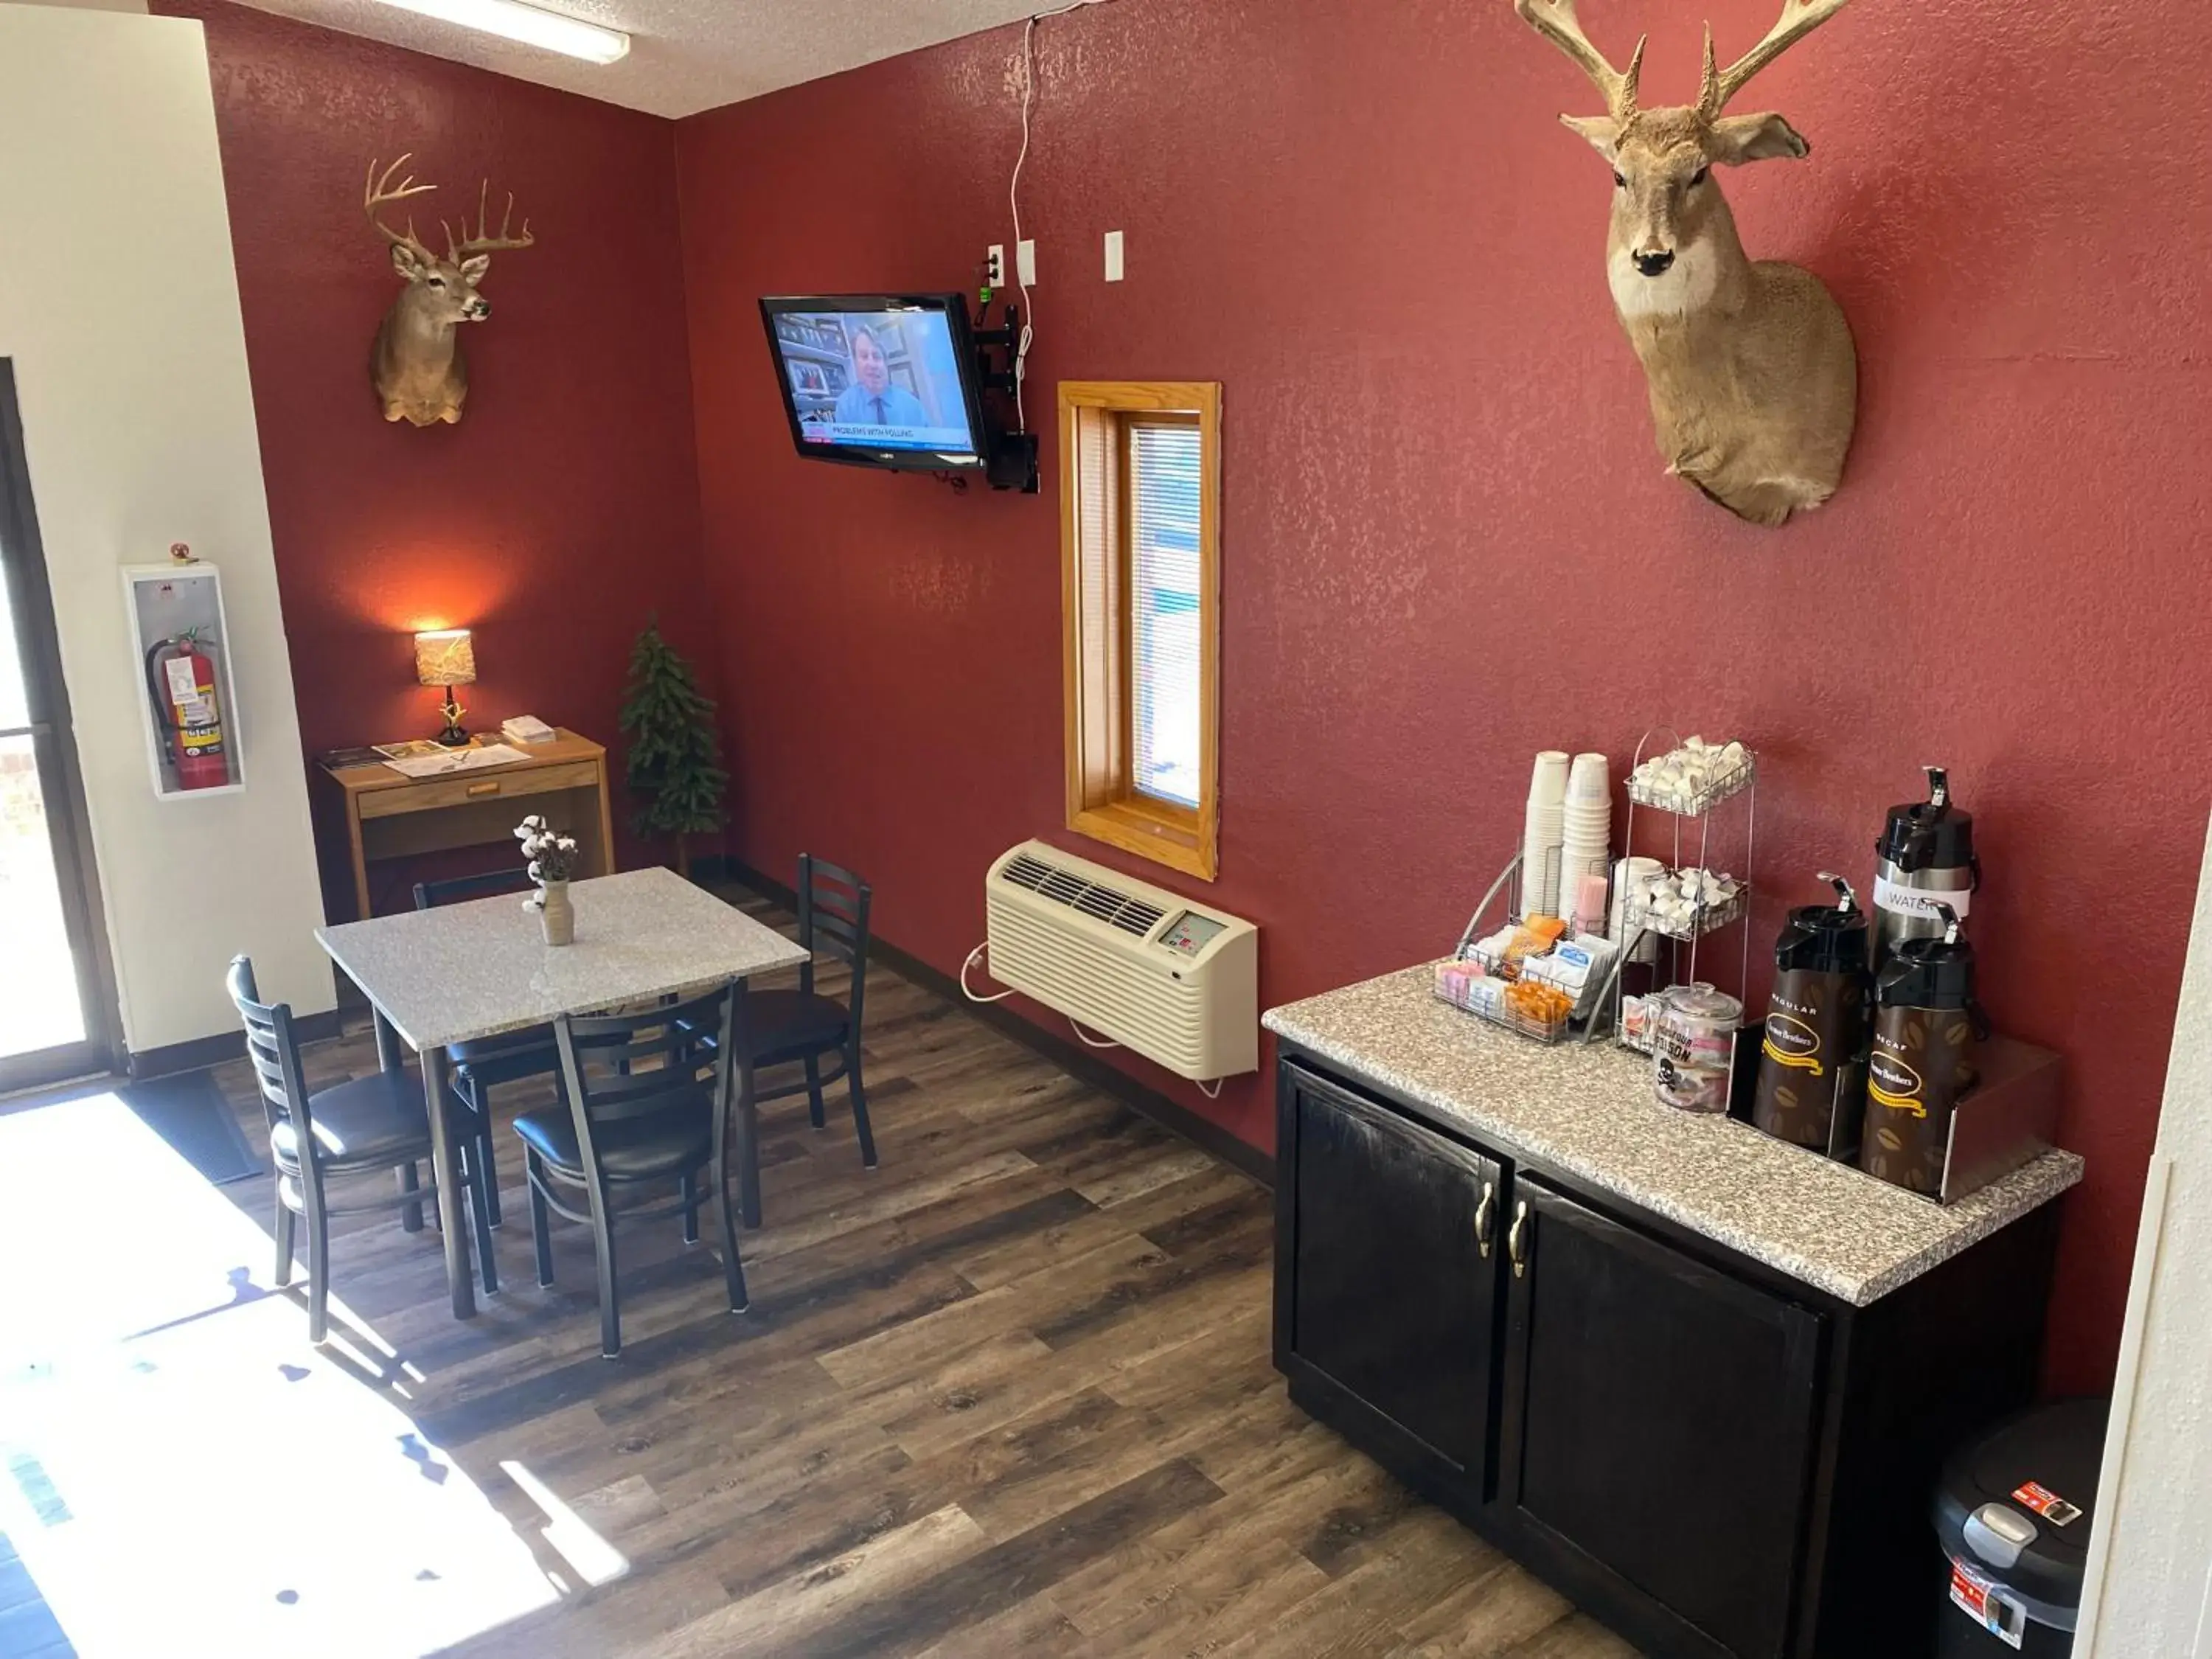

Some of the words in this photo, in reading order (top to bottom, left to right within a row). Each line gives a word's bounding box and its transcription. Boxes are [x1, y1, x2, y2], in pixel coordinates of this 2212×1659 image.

[832, 426, 866, 436] PROBLEMS
[867, 428, 884, 437] WITH
[1772, 992, 1818, 1015] REGULAR
[1655, 1035, 1691, 1062] POISON
[1877, 1033, 1907, 1051] DECAF
